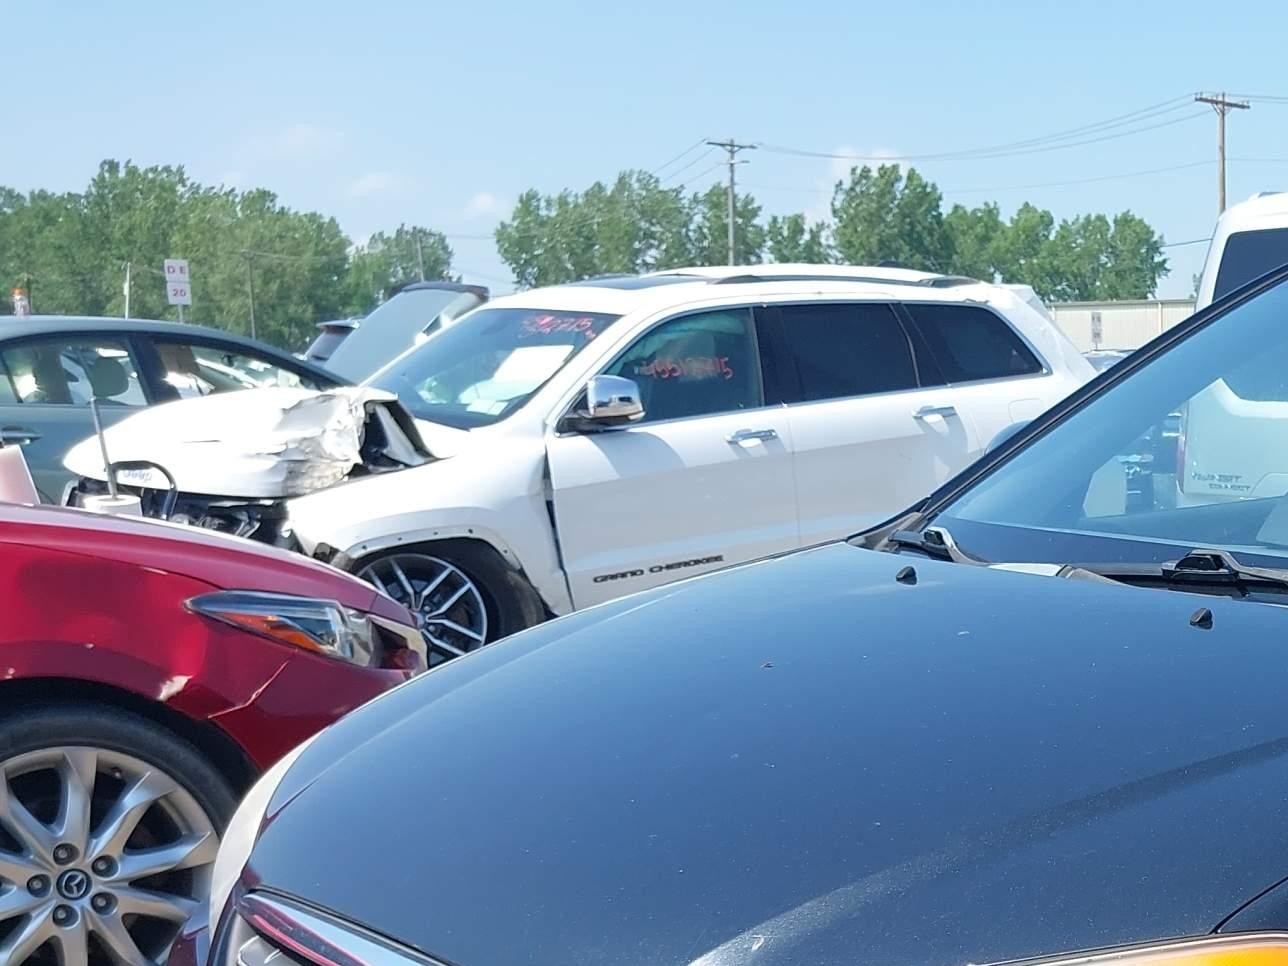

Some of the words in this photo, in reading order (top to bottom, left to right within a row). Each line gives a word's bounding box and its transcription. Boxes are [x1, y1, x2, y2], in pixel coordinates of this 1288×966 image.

[172, 288, 187, 297] 20
[593, 570, 645, 583] GRAND
[649, 555, 725, 574] CHEROKEE
